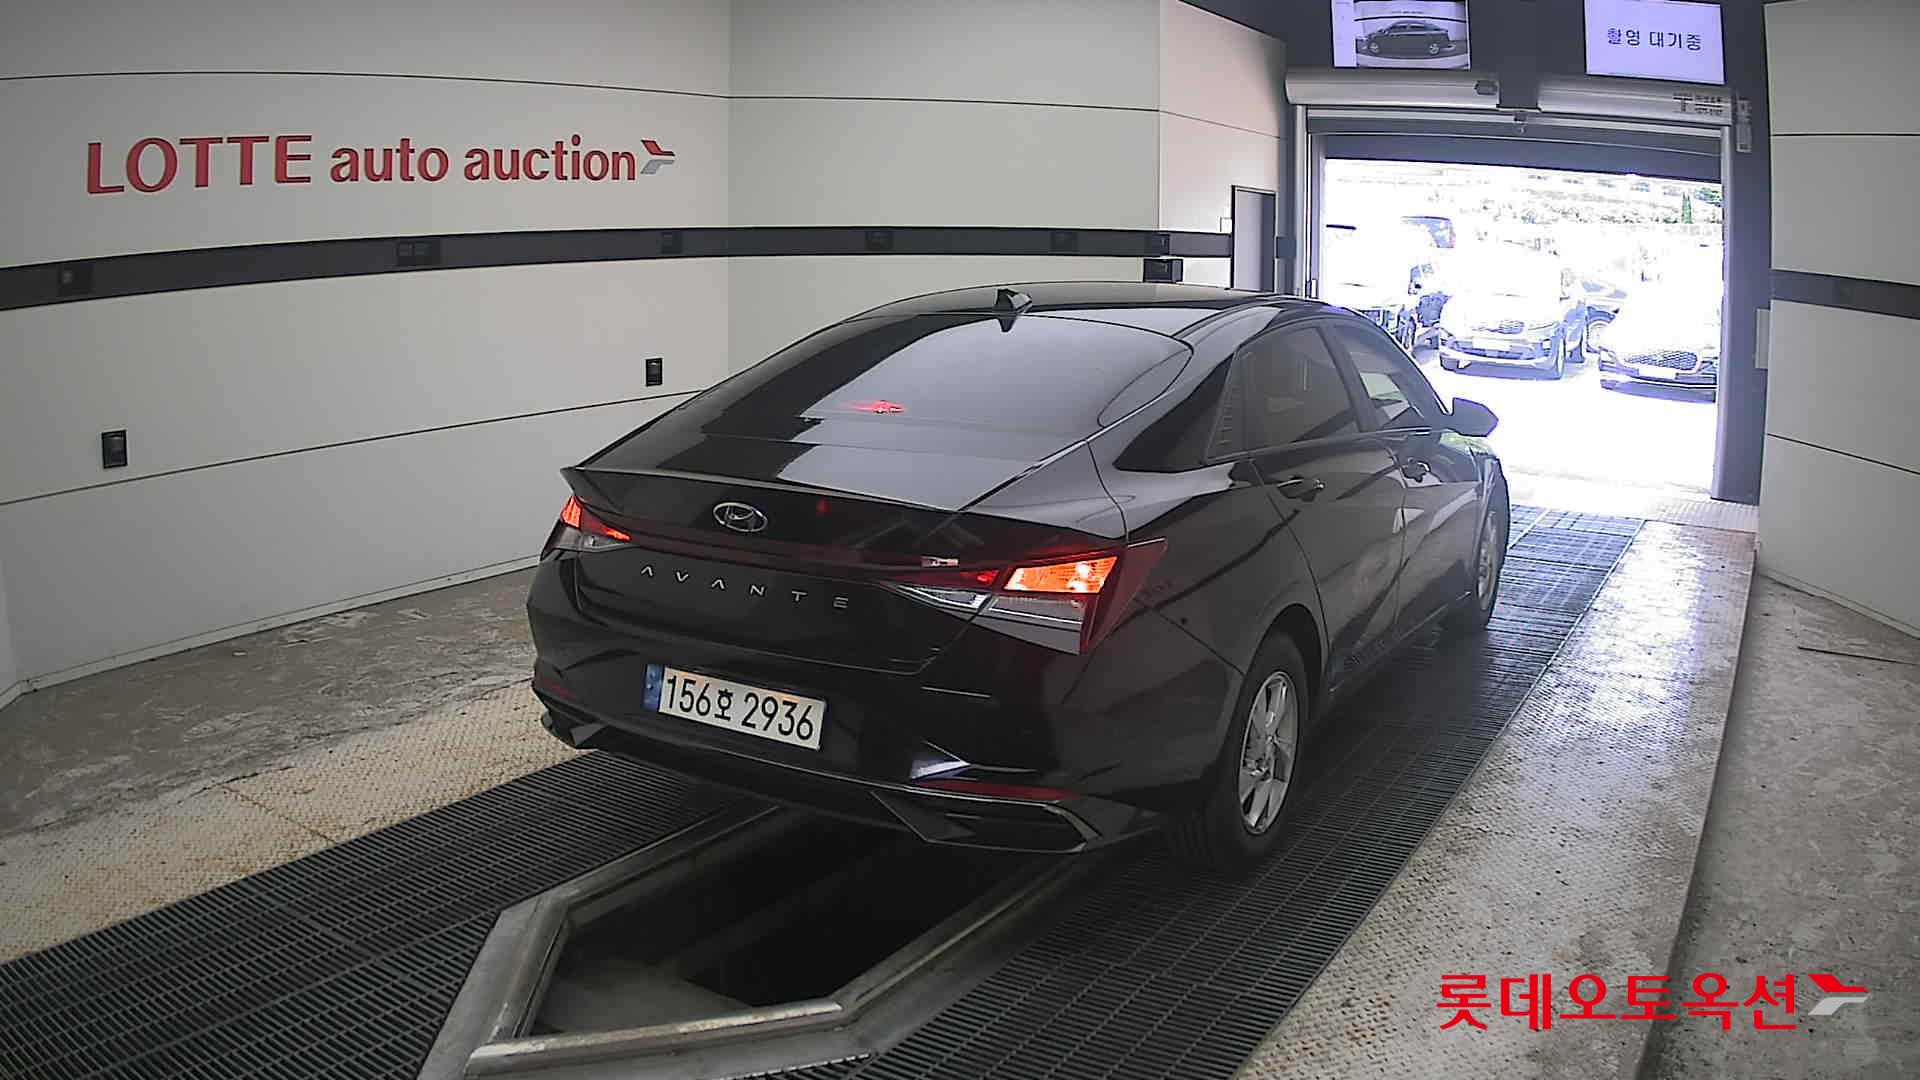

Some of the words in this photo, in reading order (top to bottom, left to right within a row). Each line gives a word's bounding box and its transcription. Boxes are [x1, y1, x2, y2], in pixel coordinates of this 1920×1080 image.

[1649, 31, 1702, 51] 대기중
[87, 135, 312, 194] LOTTE
[330, 138, 449, 183] auto
[463, 134, 637, 182] auction
[641, 566, 849, 608] AVANTE
[667, 675, 734, 721] 156호
[741, 692, 814, 740] 2936
